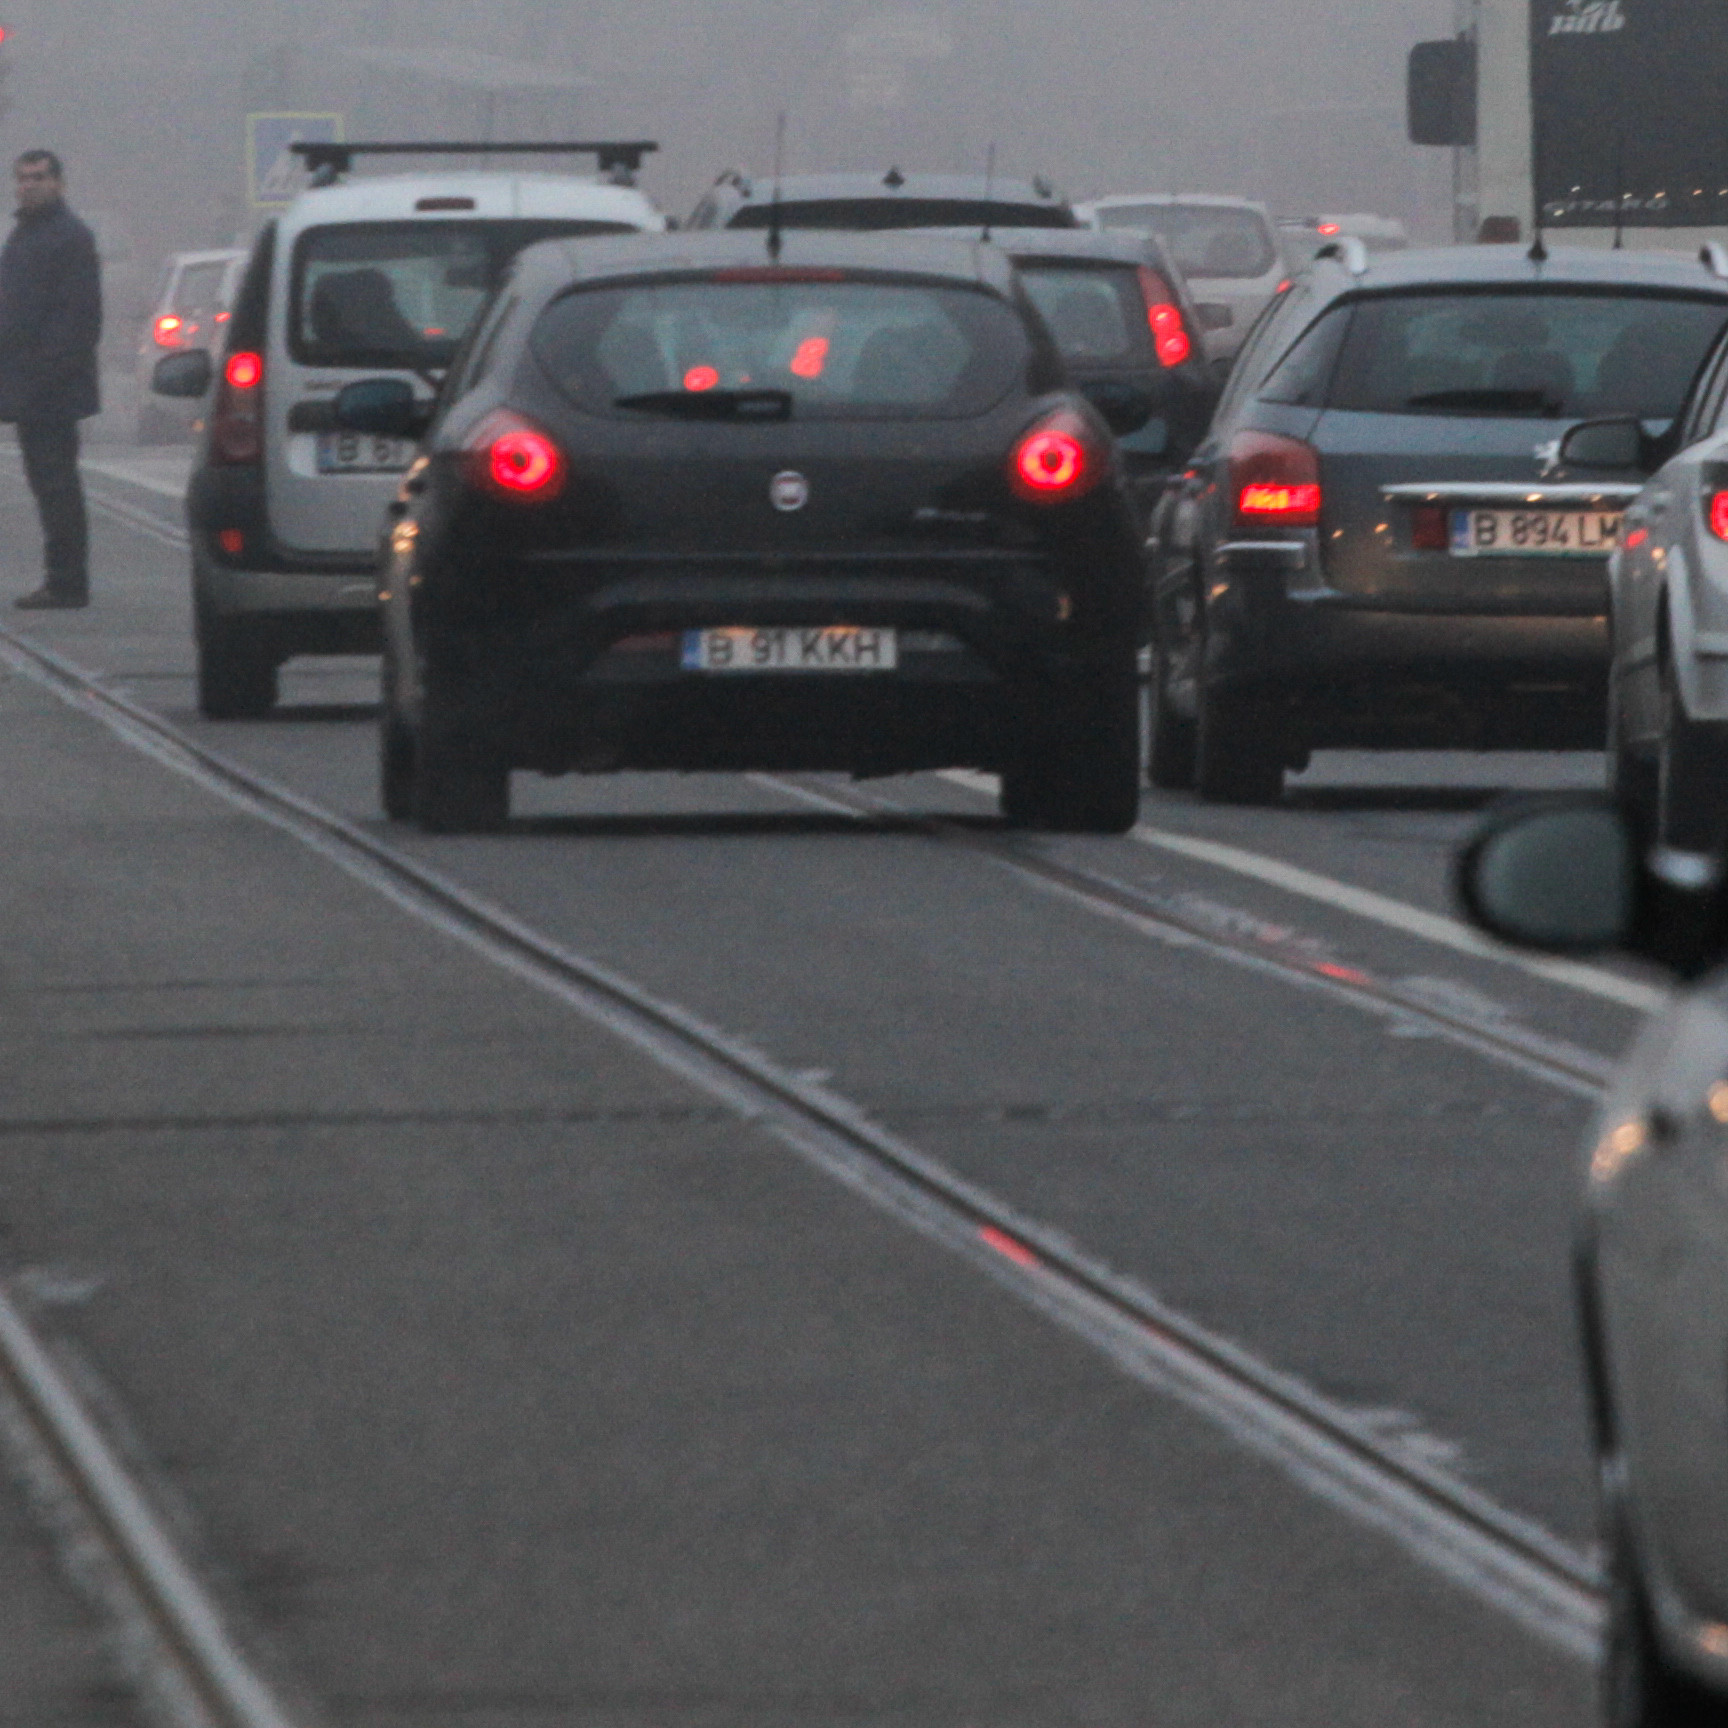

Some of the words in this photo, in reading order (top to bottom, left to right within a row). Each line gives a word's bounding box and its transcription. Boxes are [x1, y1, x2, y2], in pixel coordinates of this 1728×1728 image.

[1475, 512, 1497, 546] B
[1512, 514, 1568, 546] 894
[708, 630, 734, 666] B
[751, 628, 786, 665] 91
[800, 628, 882, 665] KKH
